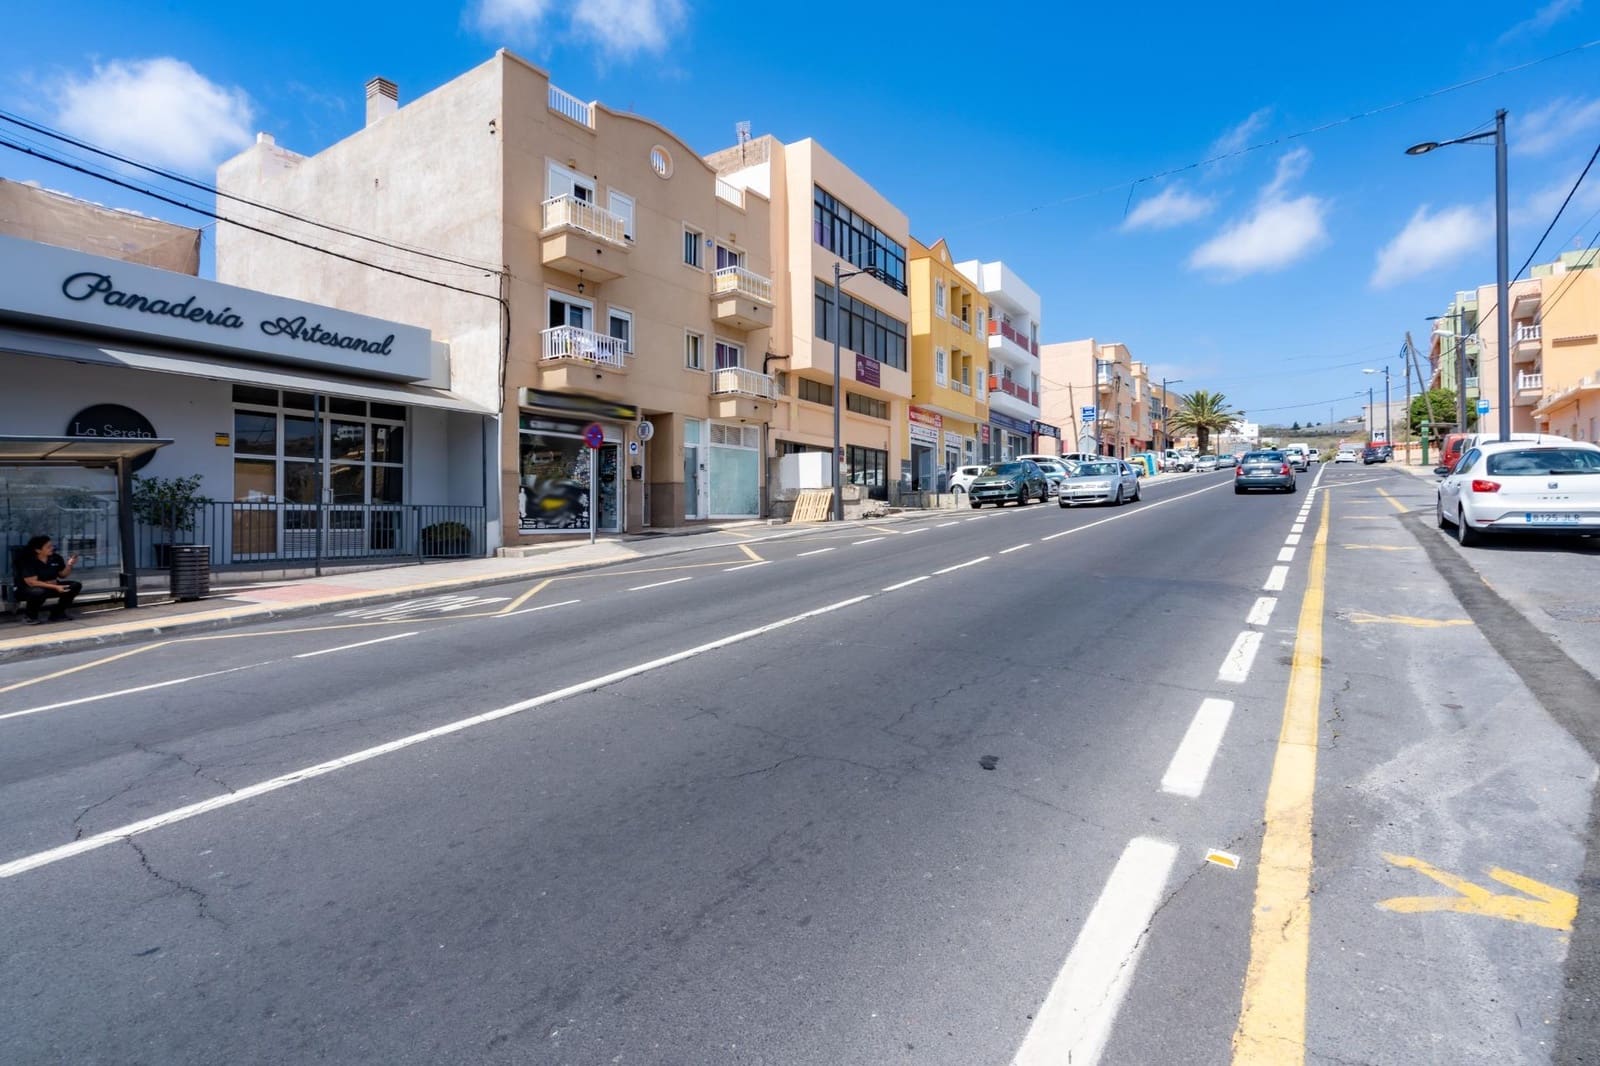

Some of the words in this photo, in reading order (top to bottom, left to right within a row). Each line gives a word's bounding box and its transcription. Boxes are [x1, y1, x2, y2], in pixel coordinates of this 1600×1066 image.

[62, 272, 244, 328] Panadería
[260, 316, 395, 356] Artesanal
[75, 422, 97, 436] La
